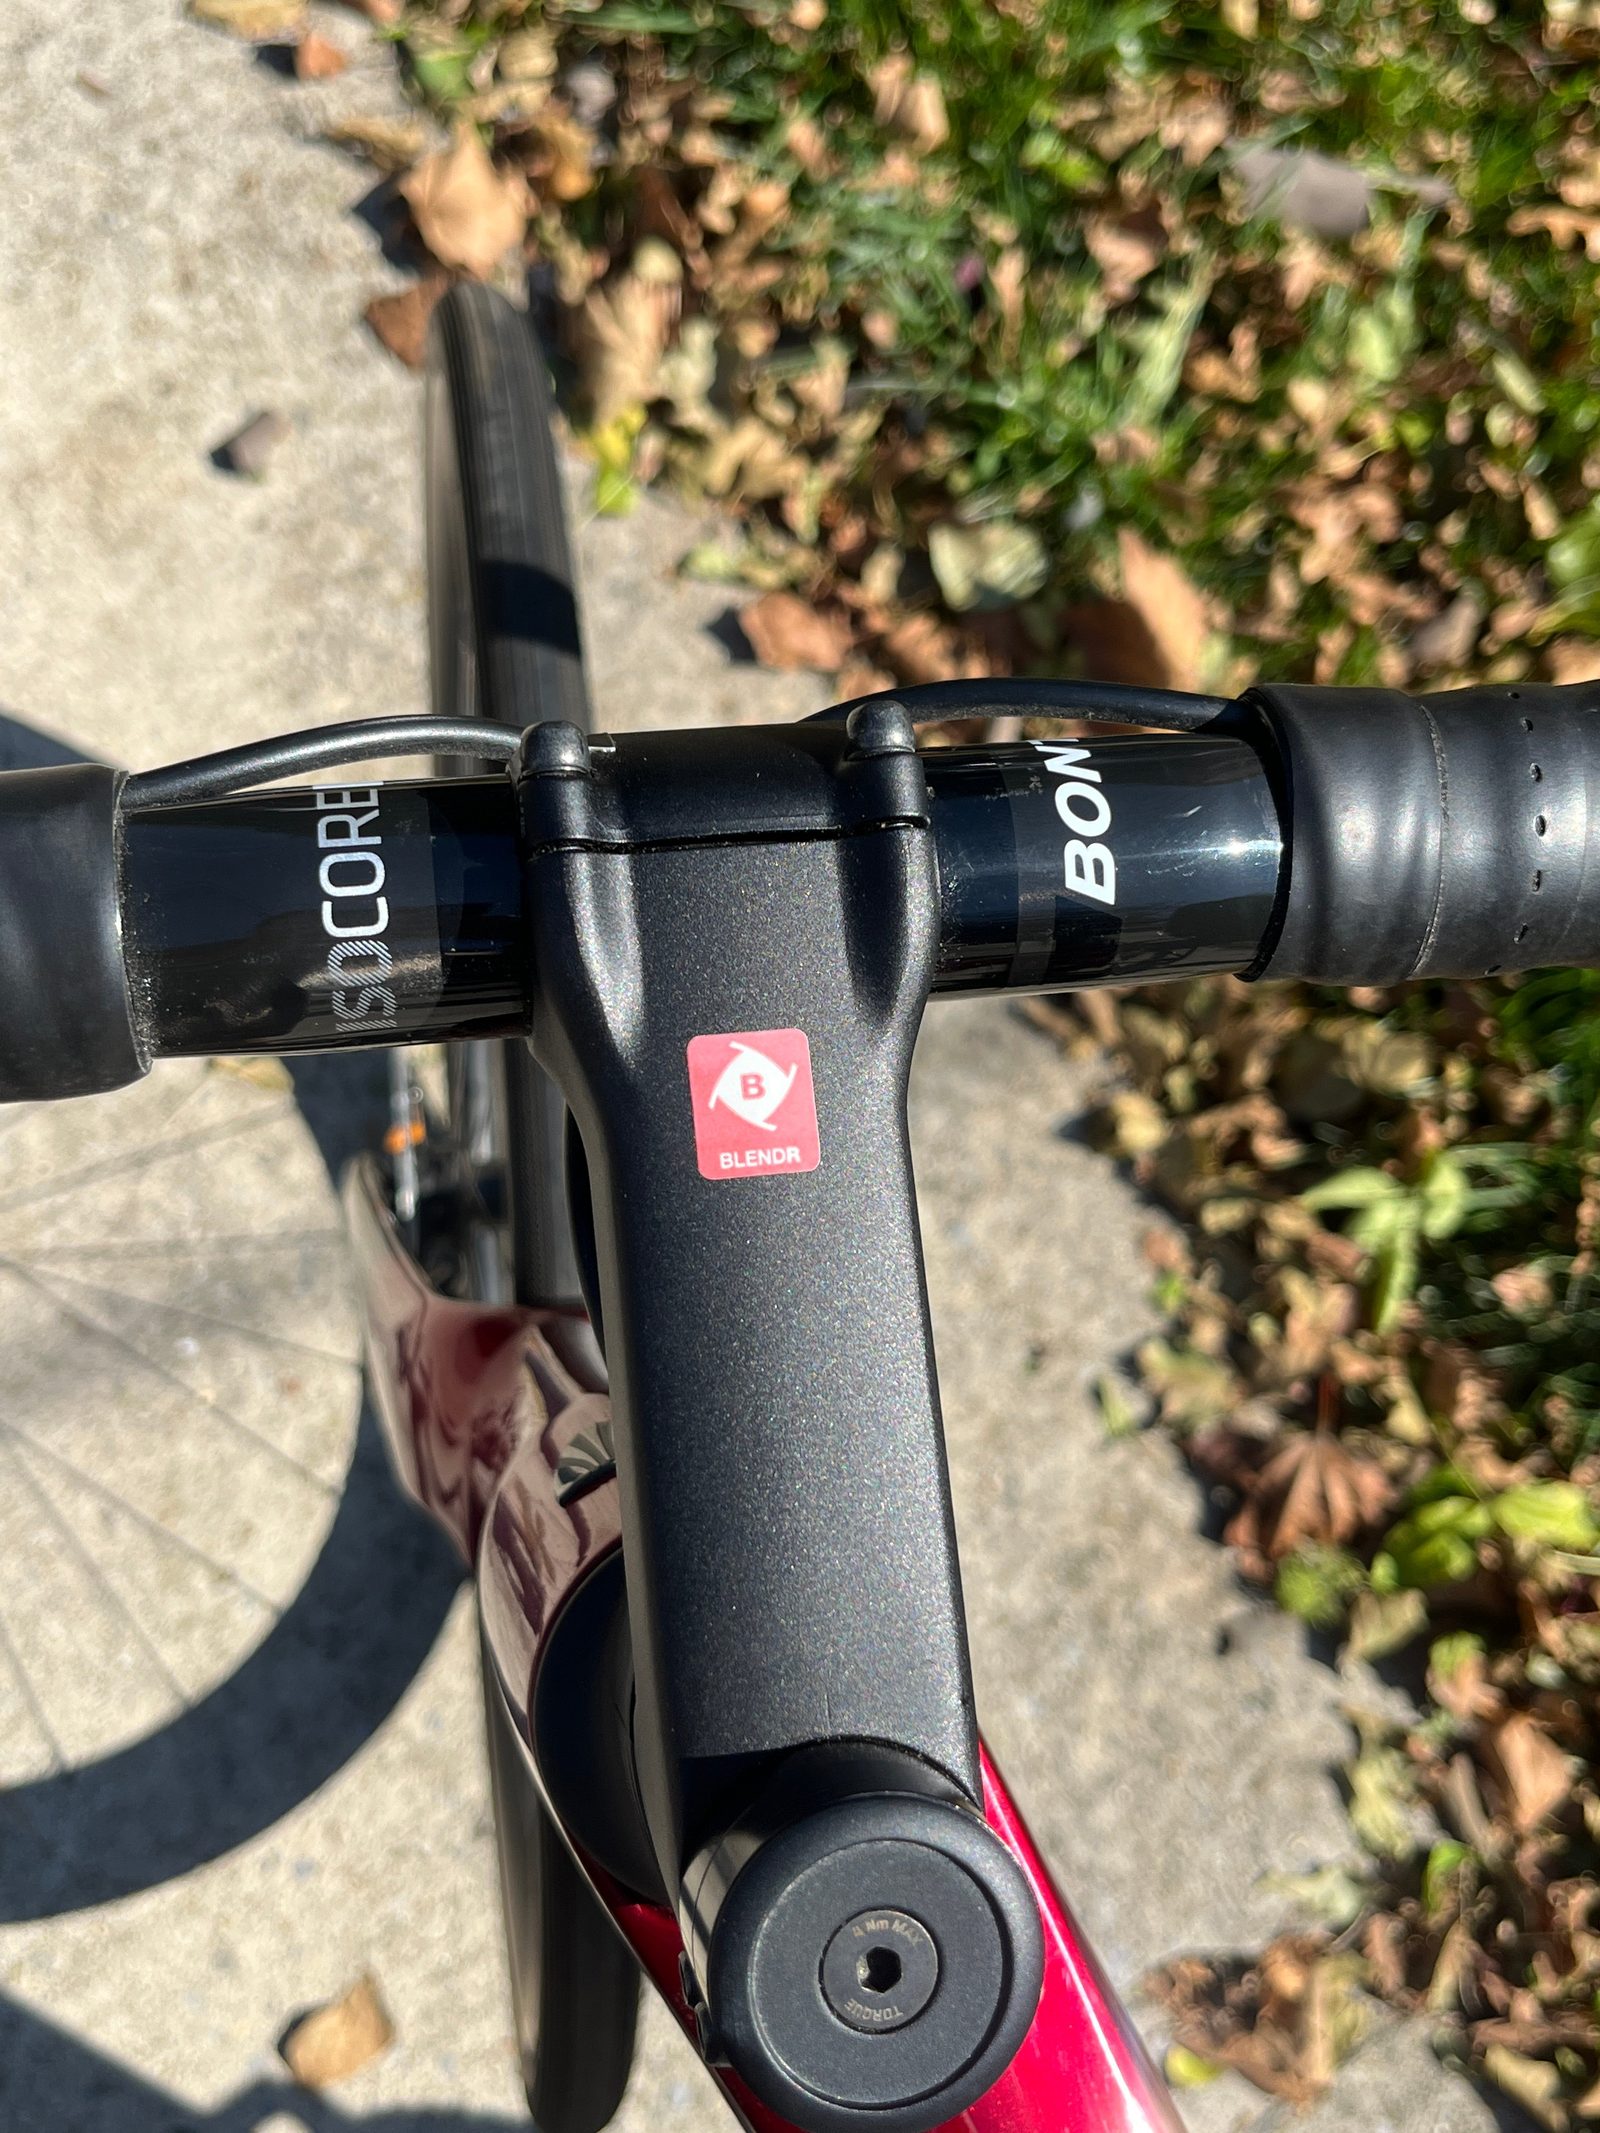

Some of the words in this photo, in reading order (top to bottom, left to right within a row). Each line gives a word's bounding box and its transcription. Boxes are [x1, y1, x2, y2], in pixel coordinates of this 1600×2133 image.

[1027, 739, 1116, 905] BON
[314, 786, 398, 1031] ISOCORE
[740, 1072, 767, 1101] B
[719, 1146, 801, 1169] BLENDR
[864, 1918, 889, 1932] Nm
[843, 1997, 904, 2021] TORQUE
